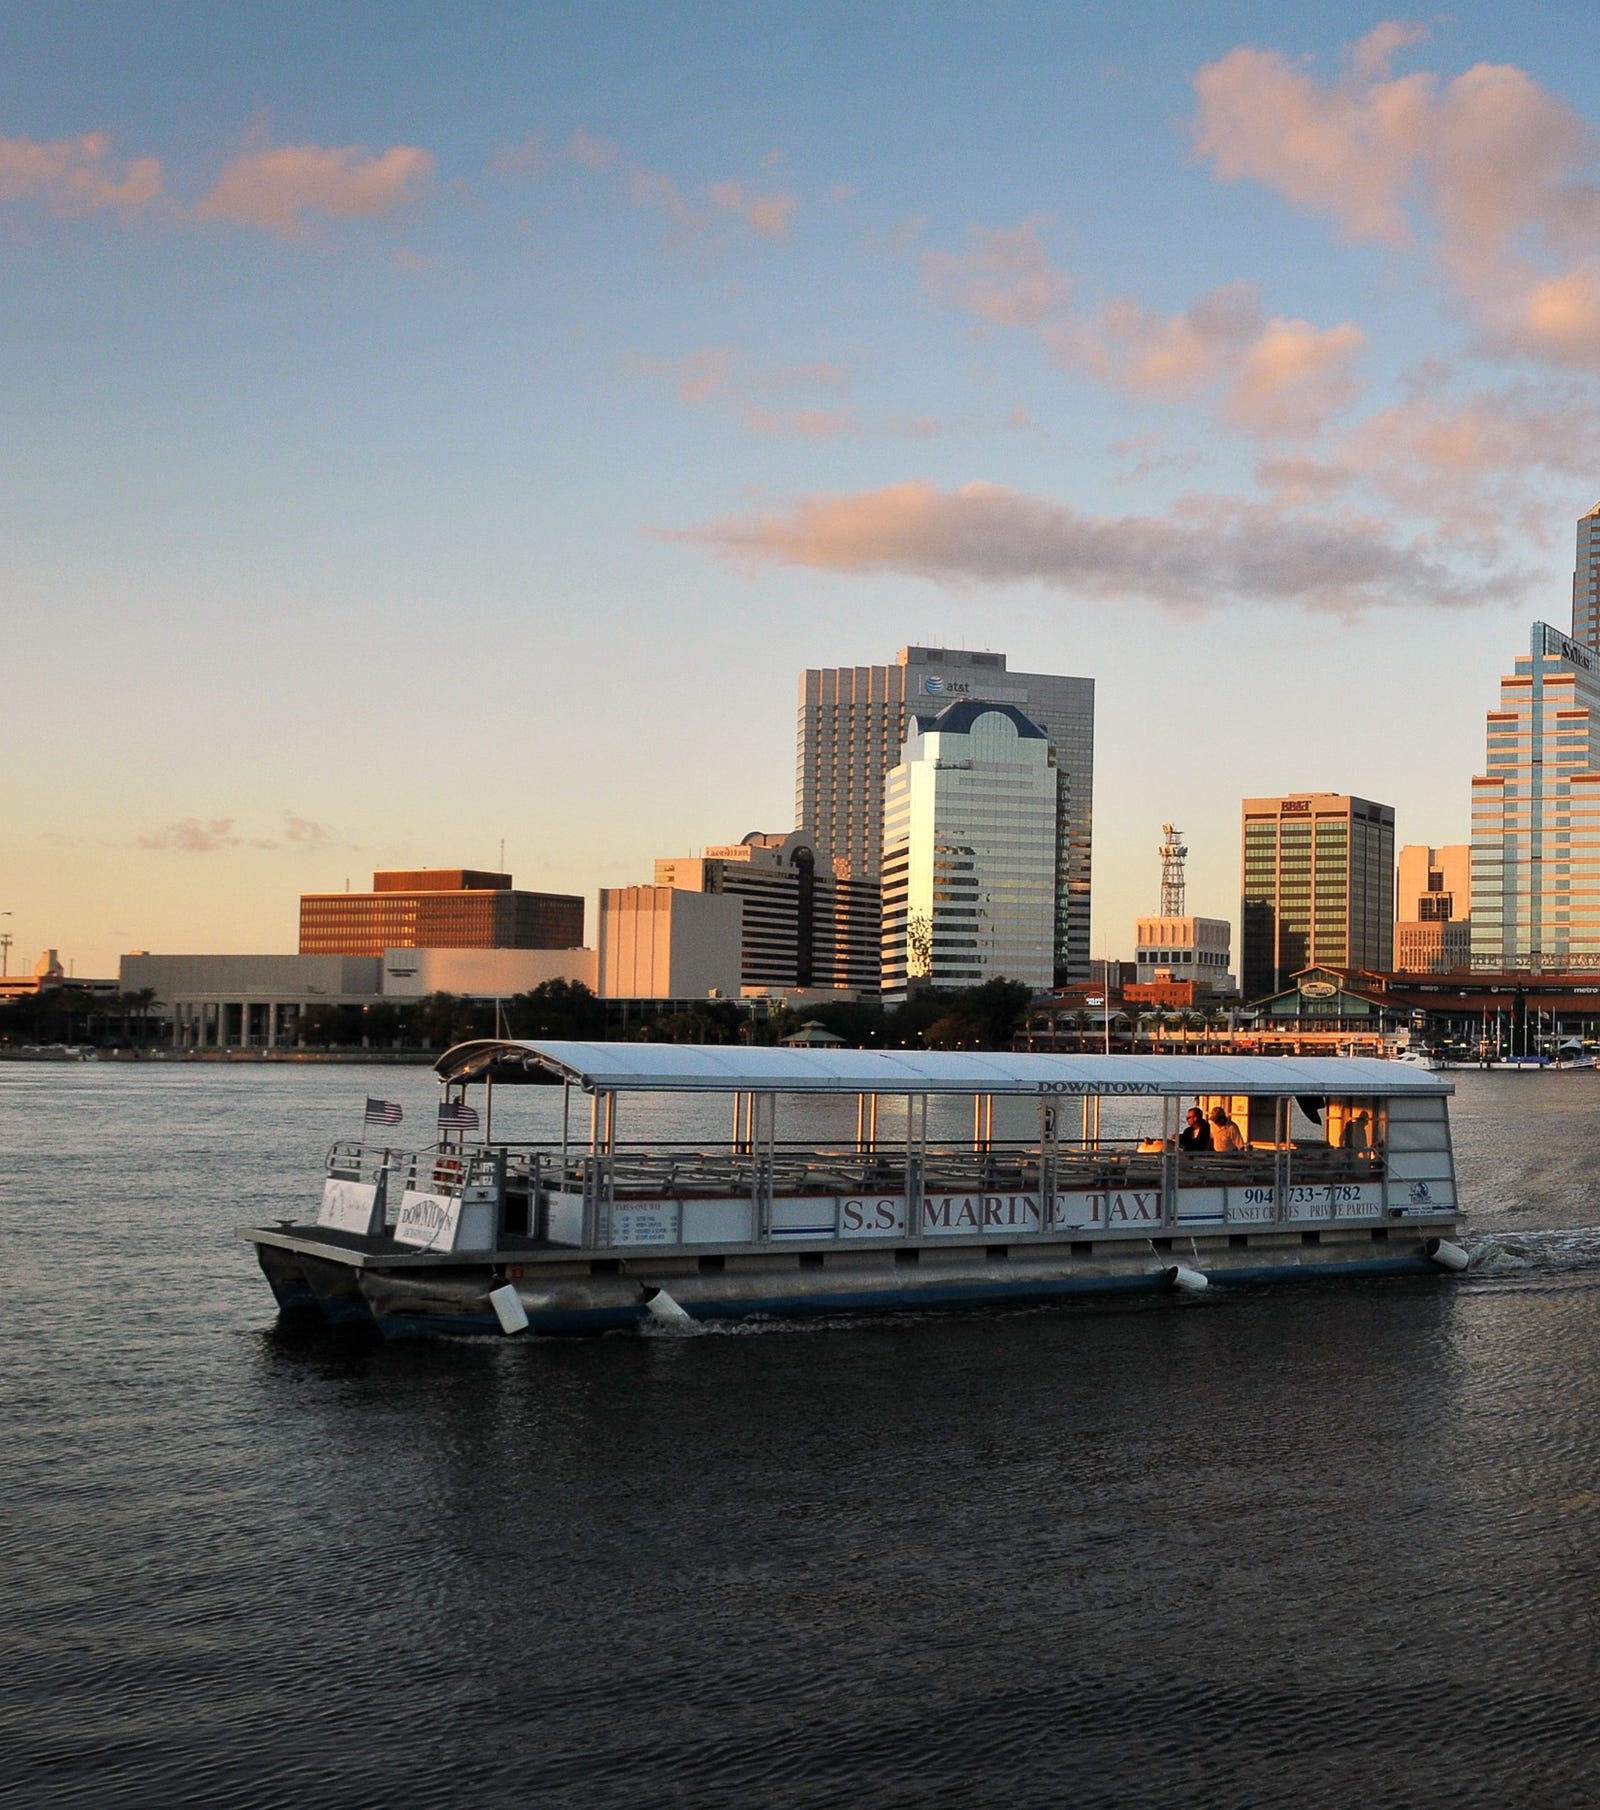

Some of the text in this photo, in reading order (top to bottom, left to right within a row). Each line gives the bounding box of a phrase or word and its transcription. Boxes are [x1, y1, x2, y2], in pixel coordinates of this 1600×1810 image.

[1281, 801, 1312, 811] BB&T
[1037, 1081, 1160, 1093] DOWNTOWN
[843, 1193, 1162, 1230] S.S. MARINE TAXI
[1227, 1207, 1260, 1221] SUNSET
[1346, 1202, 1379, 1216] PARTIES
